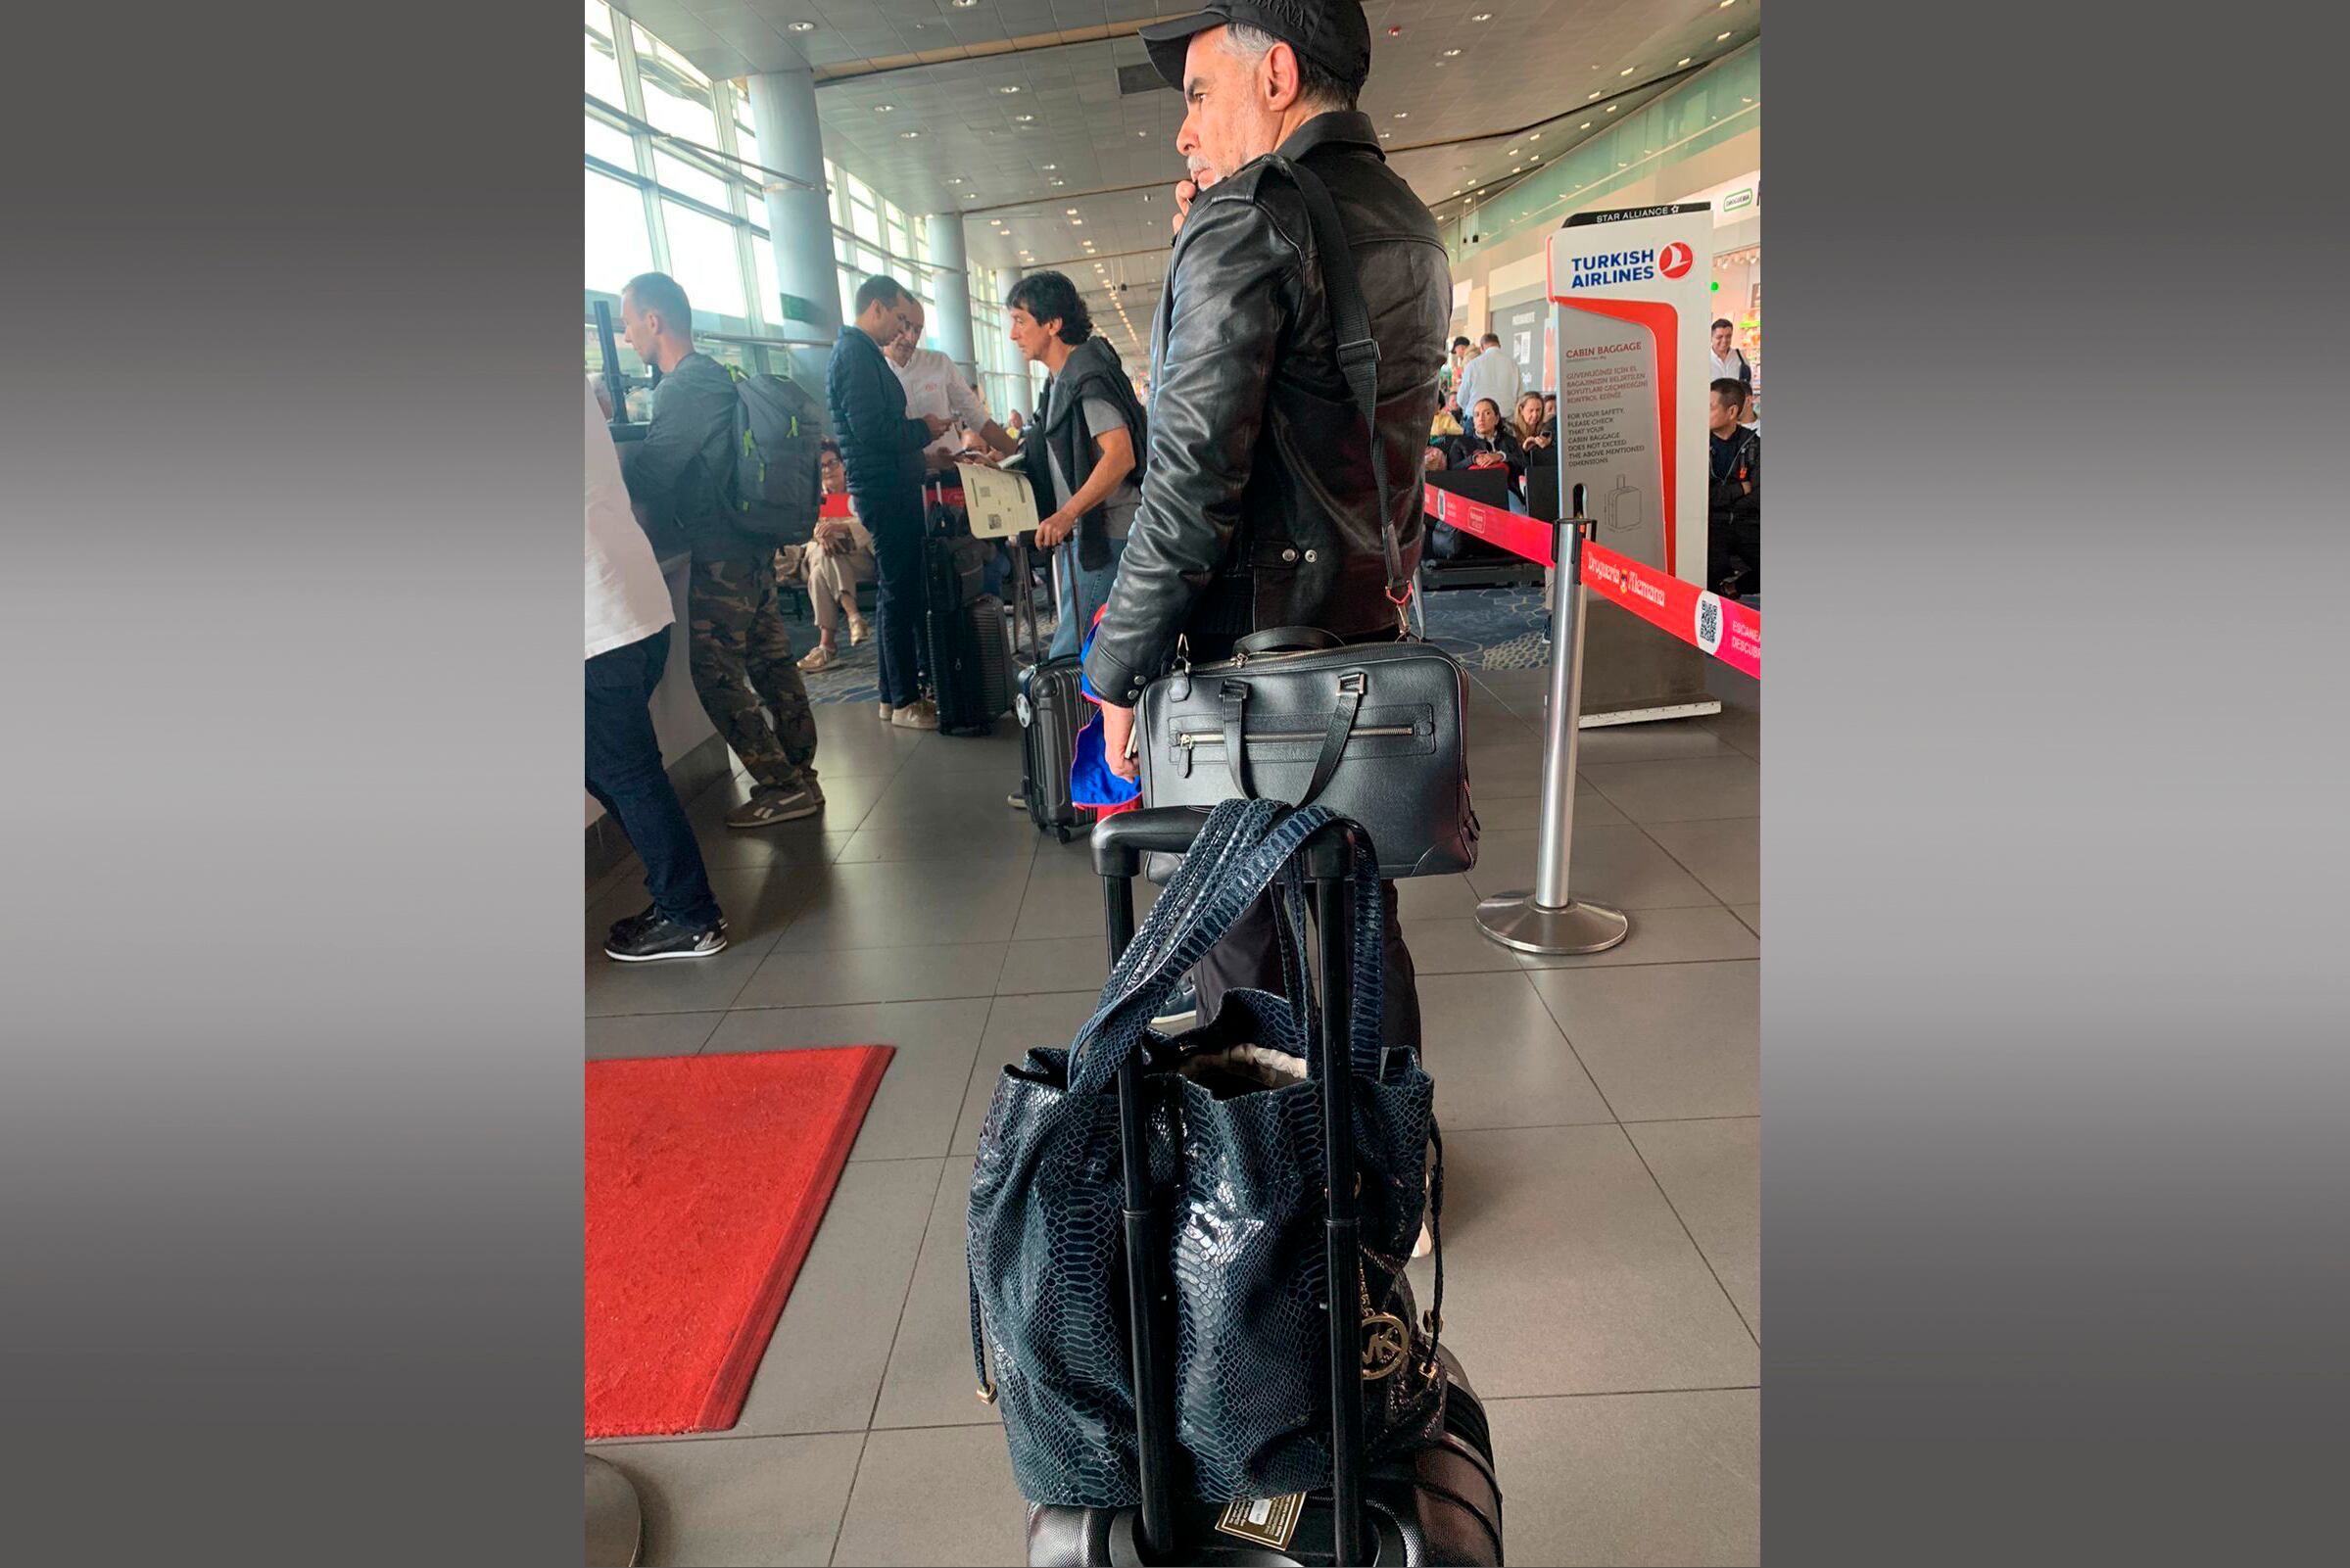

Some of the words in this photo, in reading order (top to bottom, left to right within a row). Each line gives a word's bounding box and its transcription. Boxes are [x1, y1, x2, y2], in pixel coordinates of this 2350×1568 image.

[1596, 213, 1620, 223] STAR
[1622, 207, 1668, 219] ALLIANCE
[1571, 249, 1654, 271] TURKISH
[1571, 265, 1655, 289] AIRLINES
[1566, 347, 1595, 358] CABIN
[1597, 341, 1642, 355] BAGGAGE
[1567, 419, 1590, 428] PLEASE
[1589, 432, 1619, 441] BAGGAGE
[1603, 439, 1626, 448] EXCEED
[1606, 445, 1645, 455] MENTIONED
[1568, 457, 1608, 467] DIMENSIONS
[1628, 570, 1665, 607] Alemana
